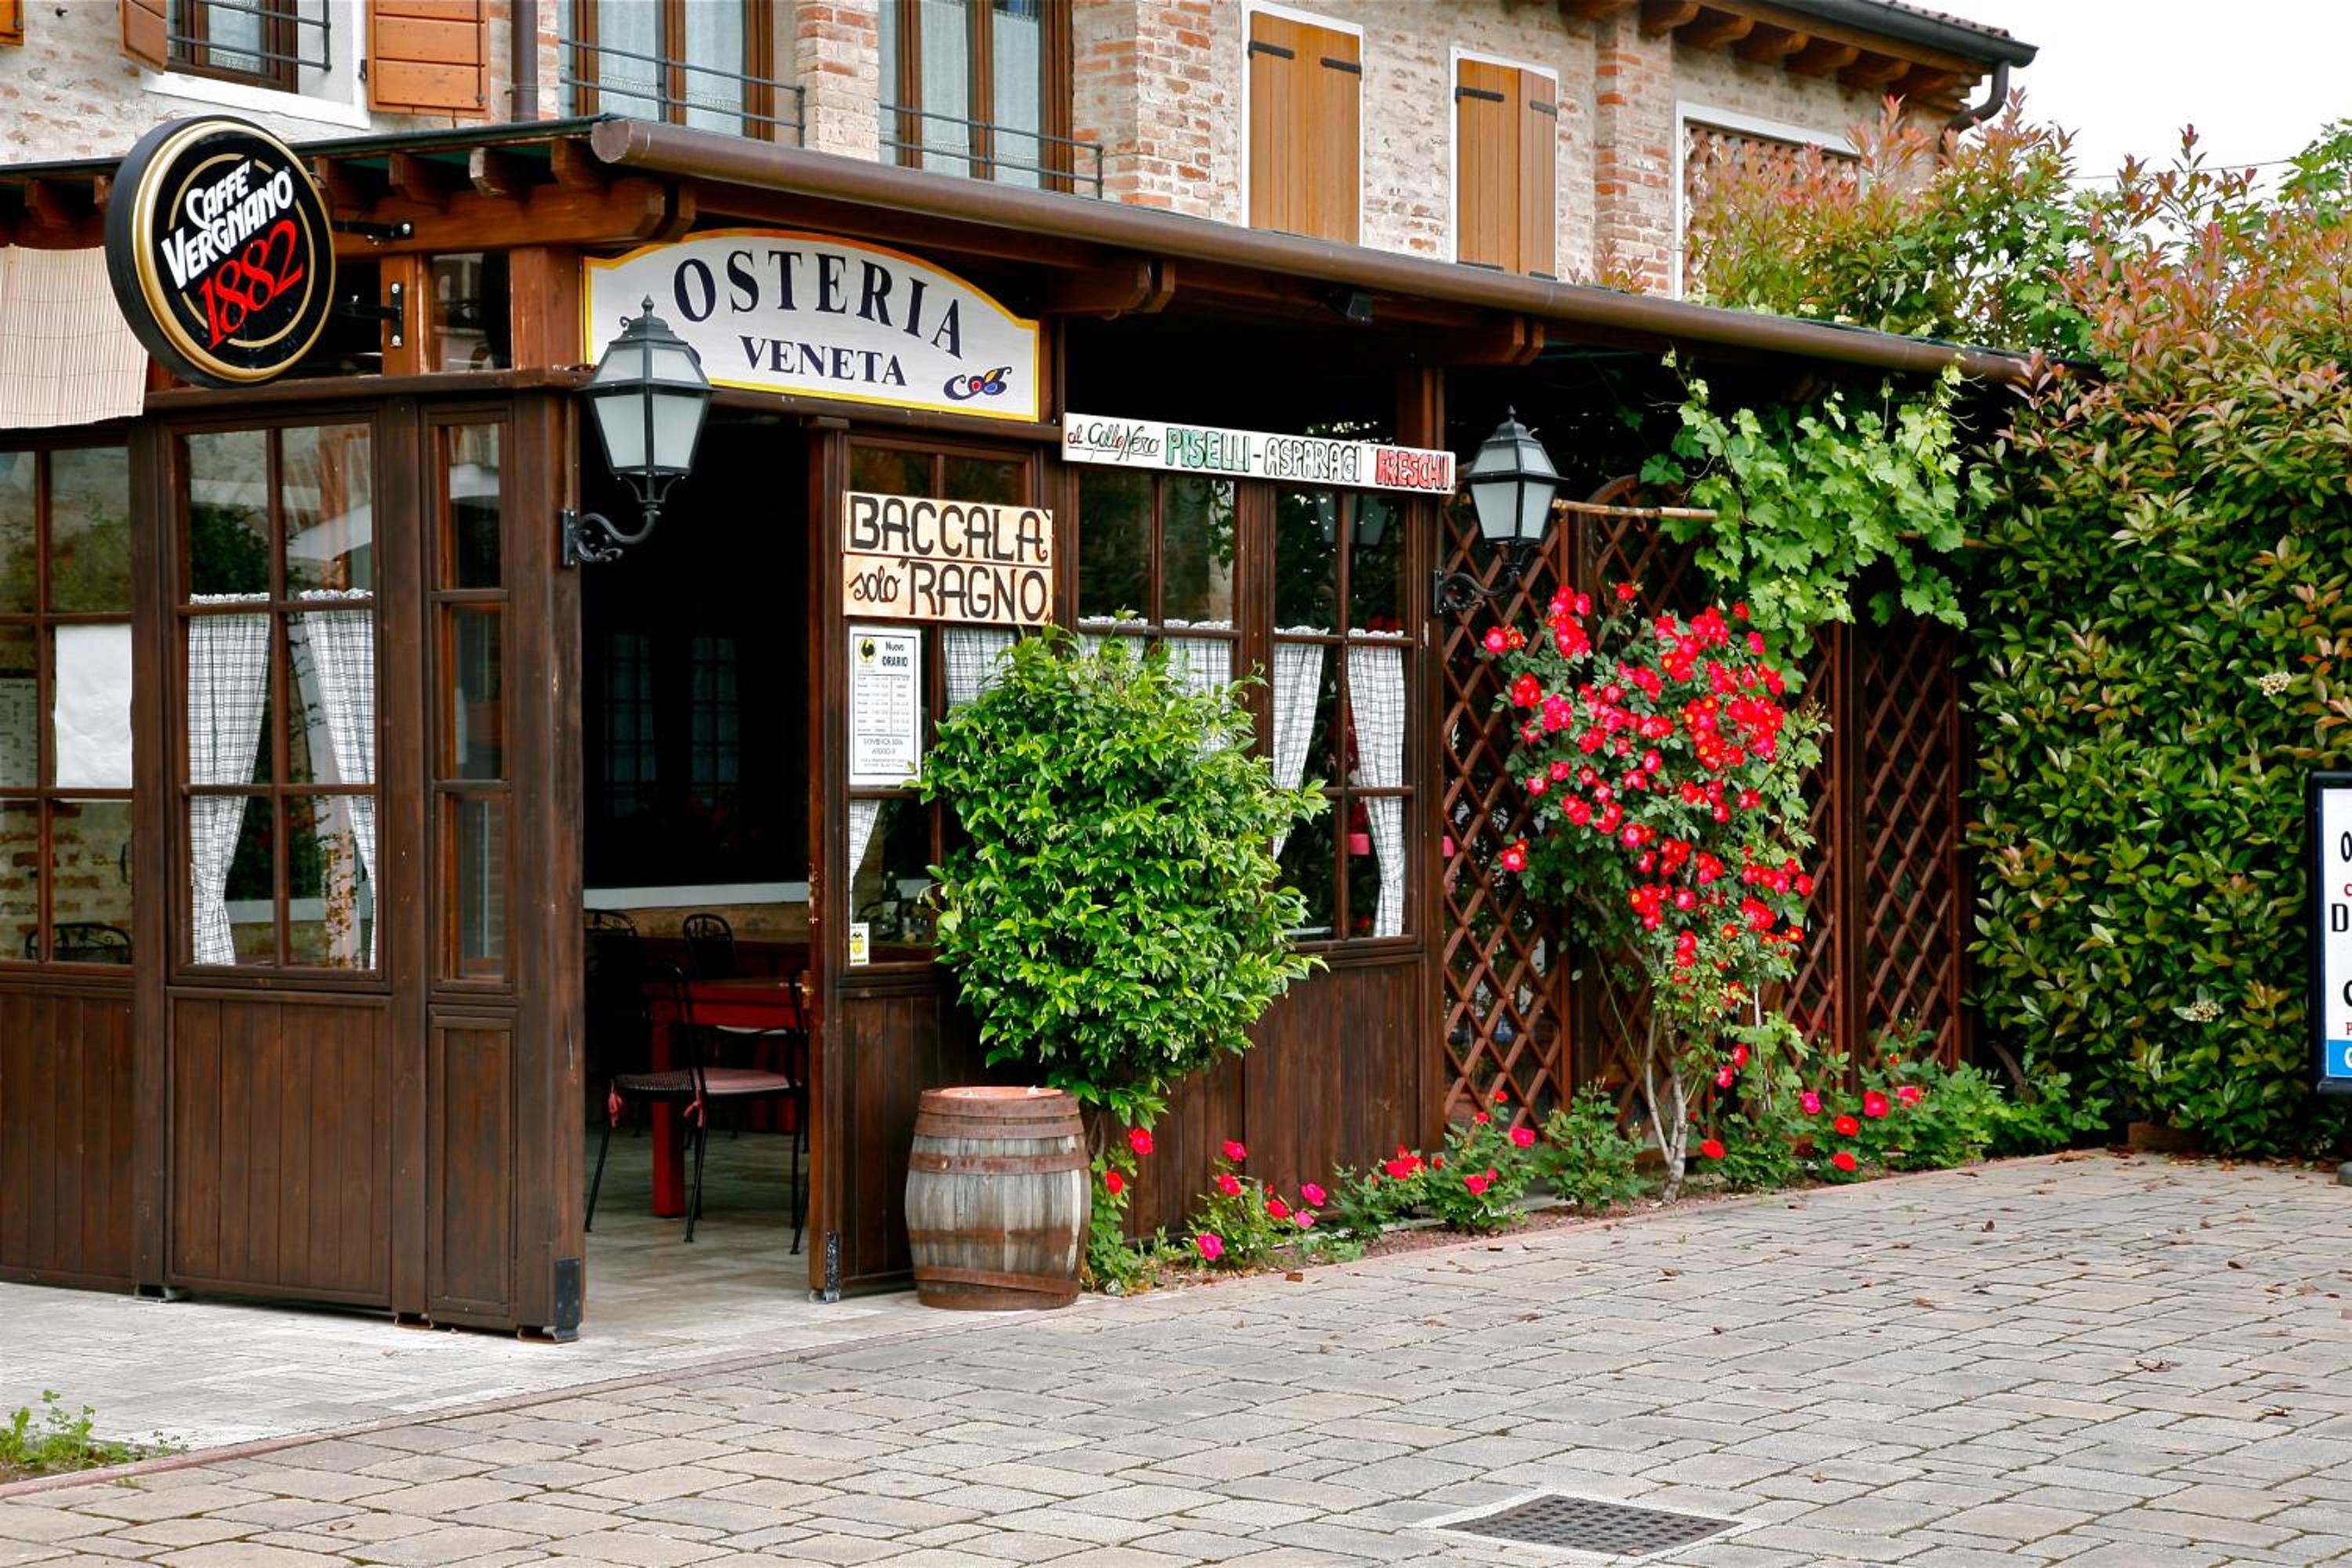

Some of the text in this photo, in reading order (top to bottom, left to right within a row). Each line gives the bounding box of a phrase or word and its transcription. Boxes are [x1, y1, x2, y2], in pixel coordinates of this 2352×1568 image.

[160, 170, 293, 289] VERGNANO
[198, 219, 303, 350] 1882
[673, 249, 964, 360] OSTERIA
[739, 336, 907, 387] VENETA
[1165, 427, 1250, 472] PISELLI
[1264, 437, 1361, 482] ASPARAGI
[882, 655, 909, 667] ORARIO
